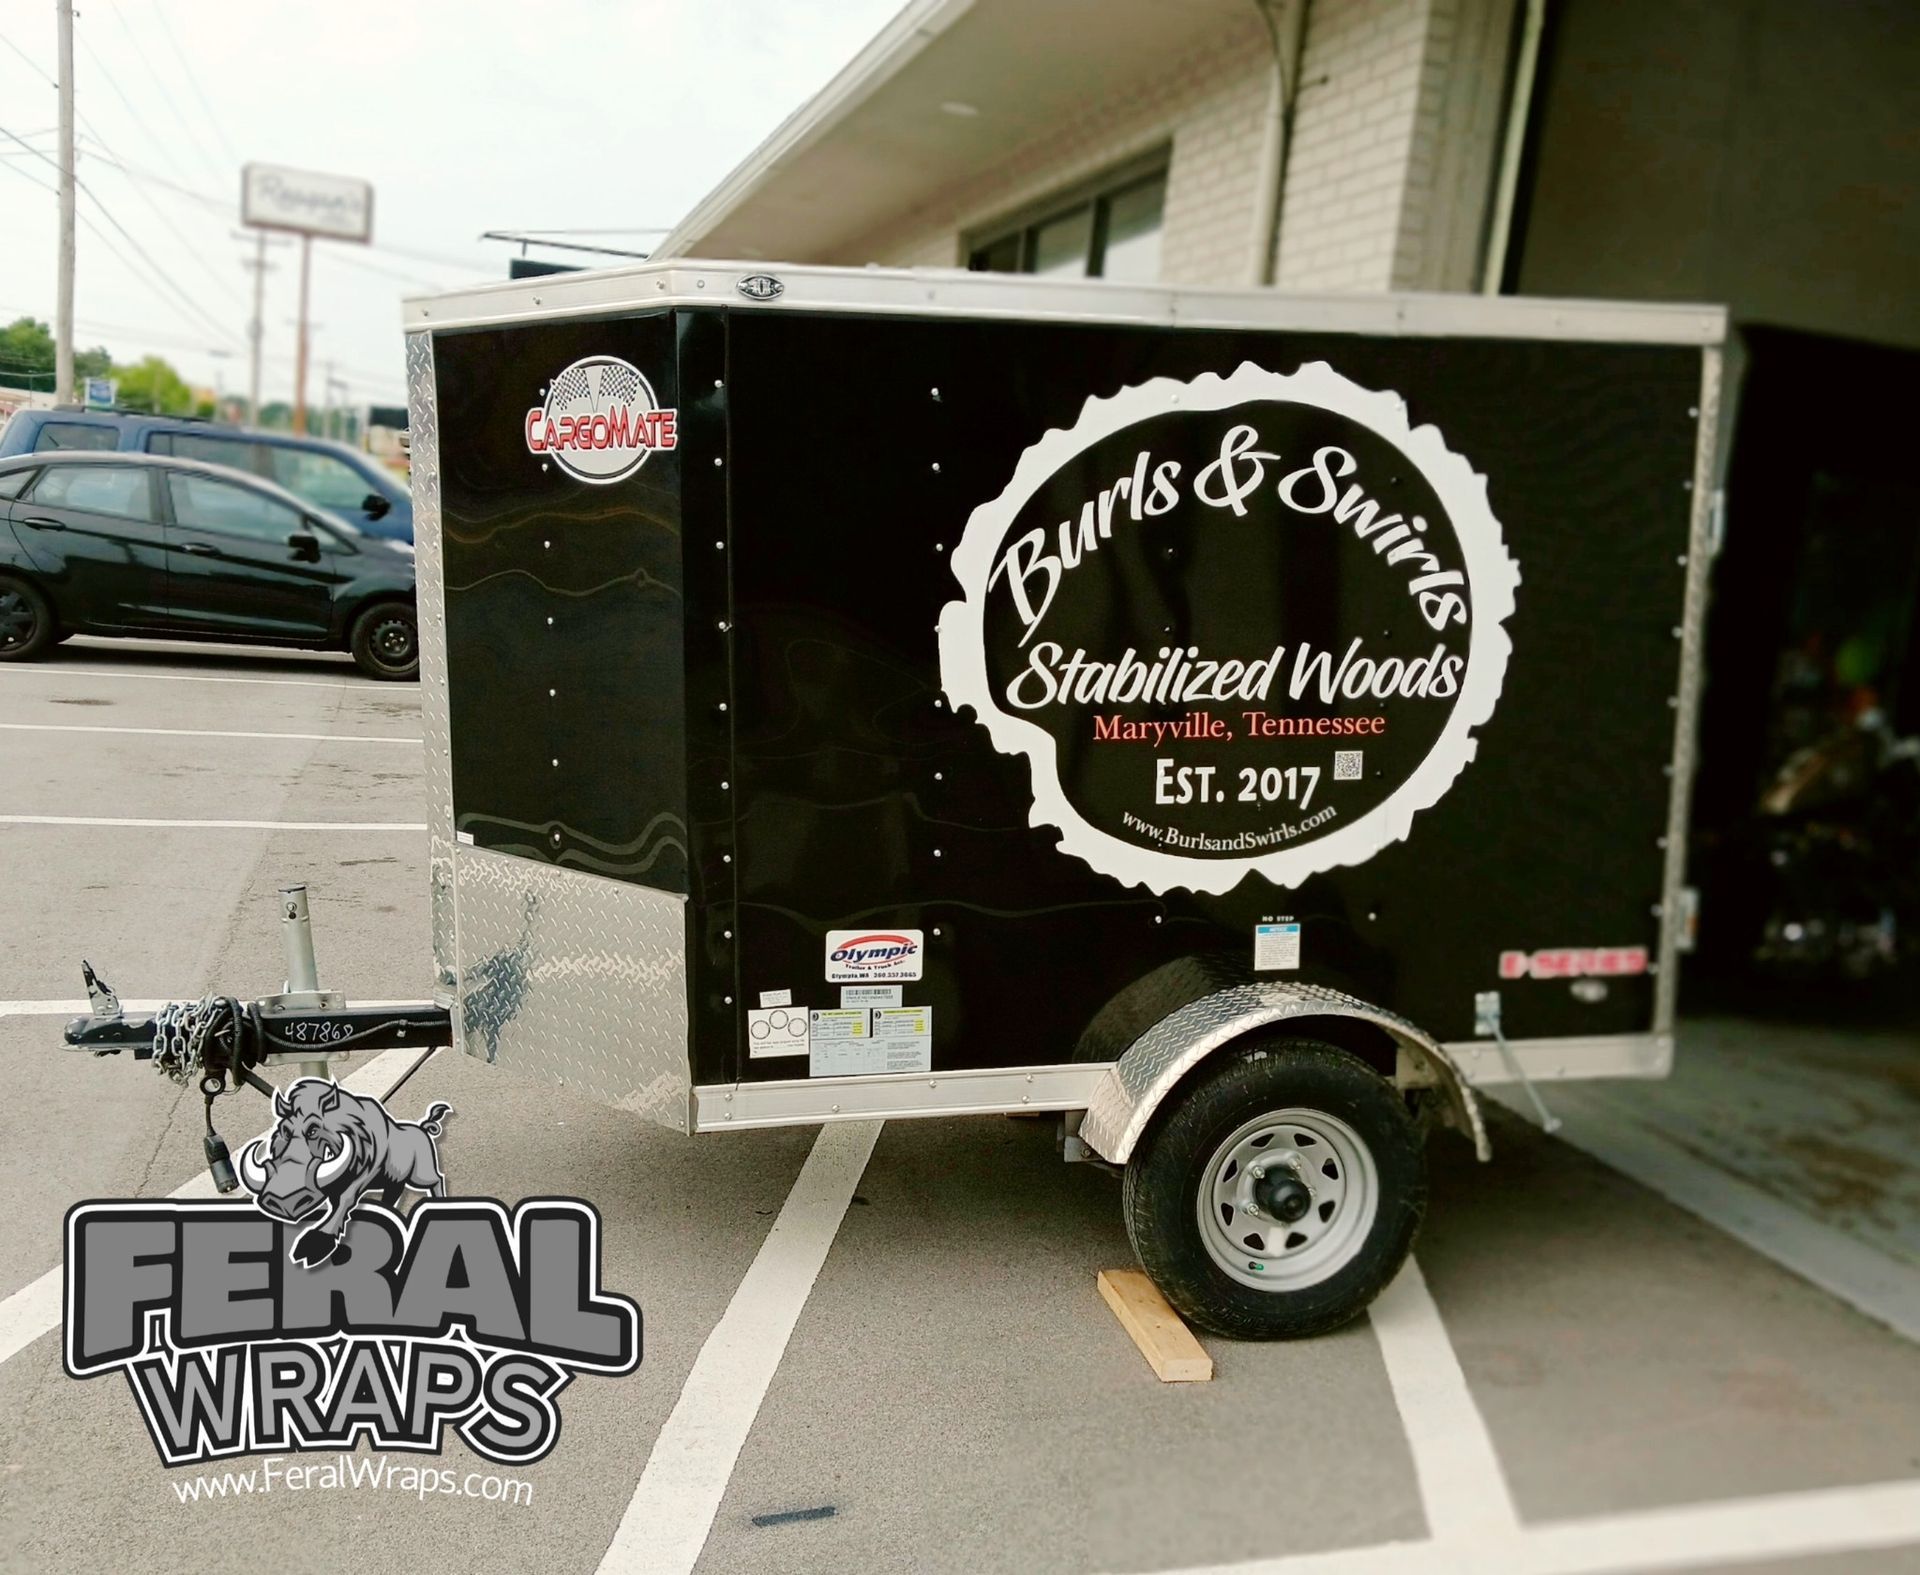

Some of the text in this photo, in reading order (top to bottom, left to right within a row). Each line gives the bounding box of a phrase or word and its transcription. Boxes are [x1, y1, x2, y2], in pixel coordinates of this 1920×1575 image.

[988, 425, 1467, 647] Burls & Swirls
[1006, 637, 1463, 709] Stabilized Woods
[1093, 711, 1385, 747] Maryville, Tennessee
[1237, 767, 1321, 810] 2017
[1122, 806, 1337, 851] www.BurlsandSwirls.com
[830, 944, 918, 963] Olympic
